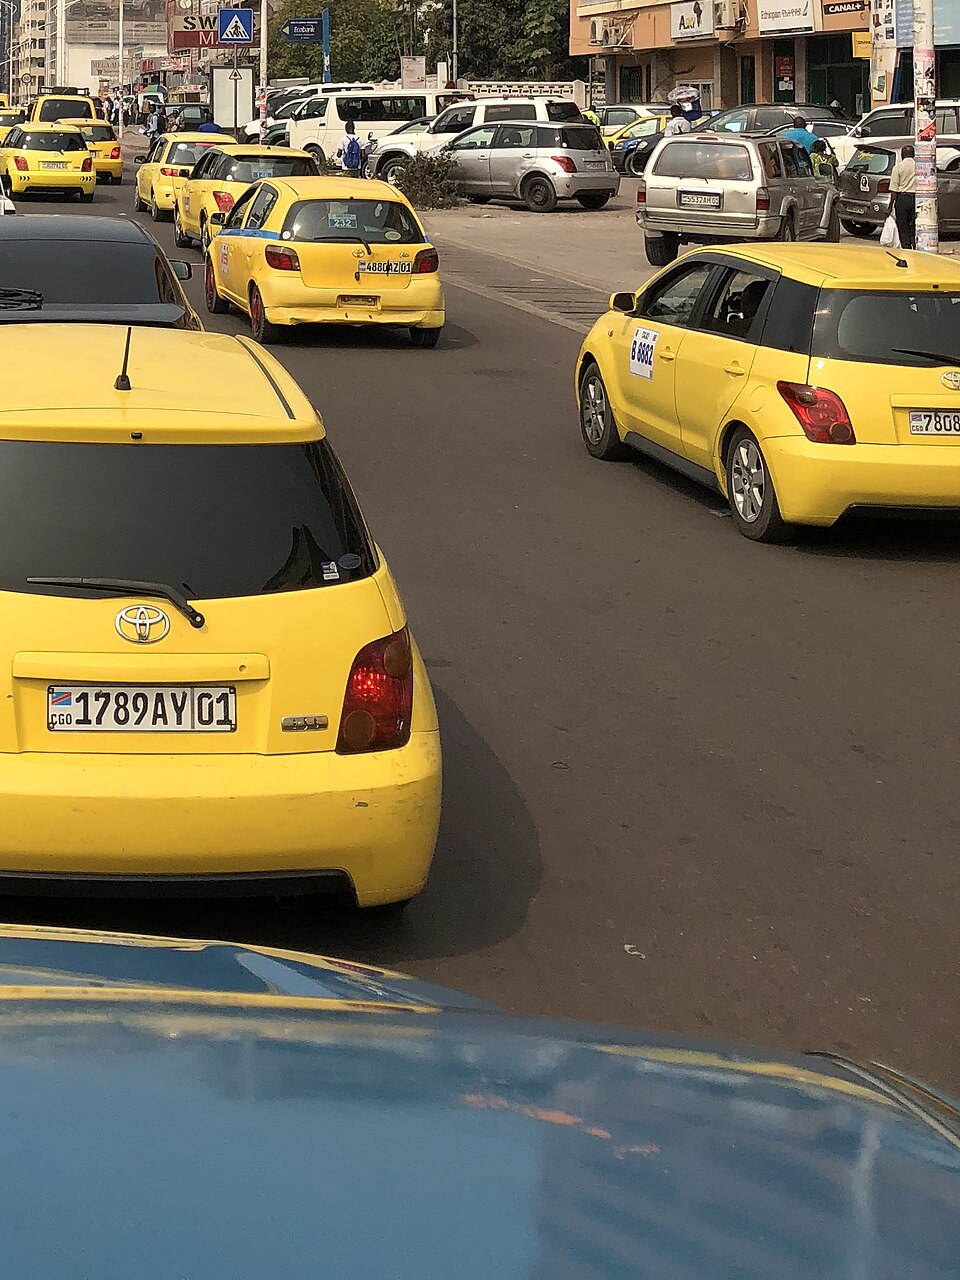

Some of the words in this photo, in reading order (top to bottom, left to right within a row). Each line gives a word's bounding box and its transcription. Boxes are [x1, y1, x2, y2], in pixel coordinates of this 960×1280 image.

[828, 2, 862, 13] CANAL+
[293, 24, 315, 33] Ecobank
[400, 262, 411, 273] 01
[75, 691, 187, 726] 1789AY
[197, 692, 233, 726] 01
[50, 713, 72, 726] CGO
